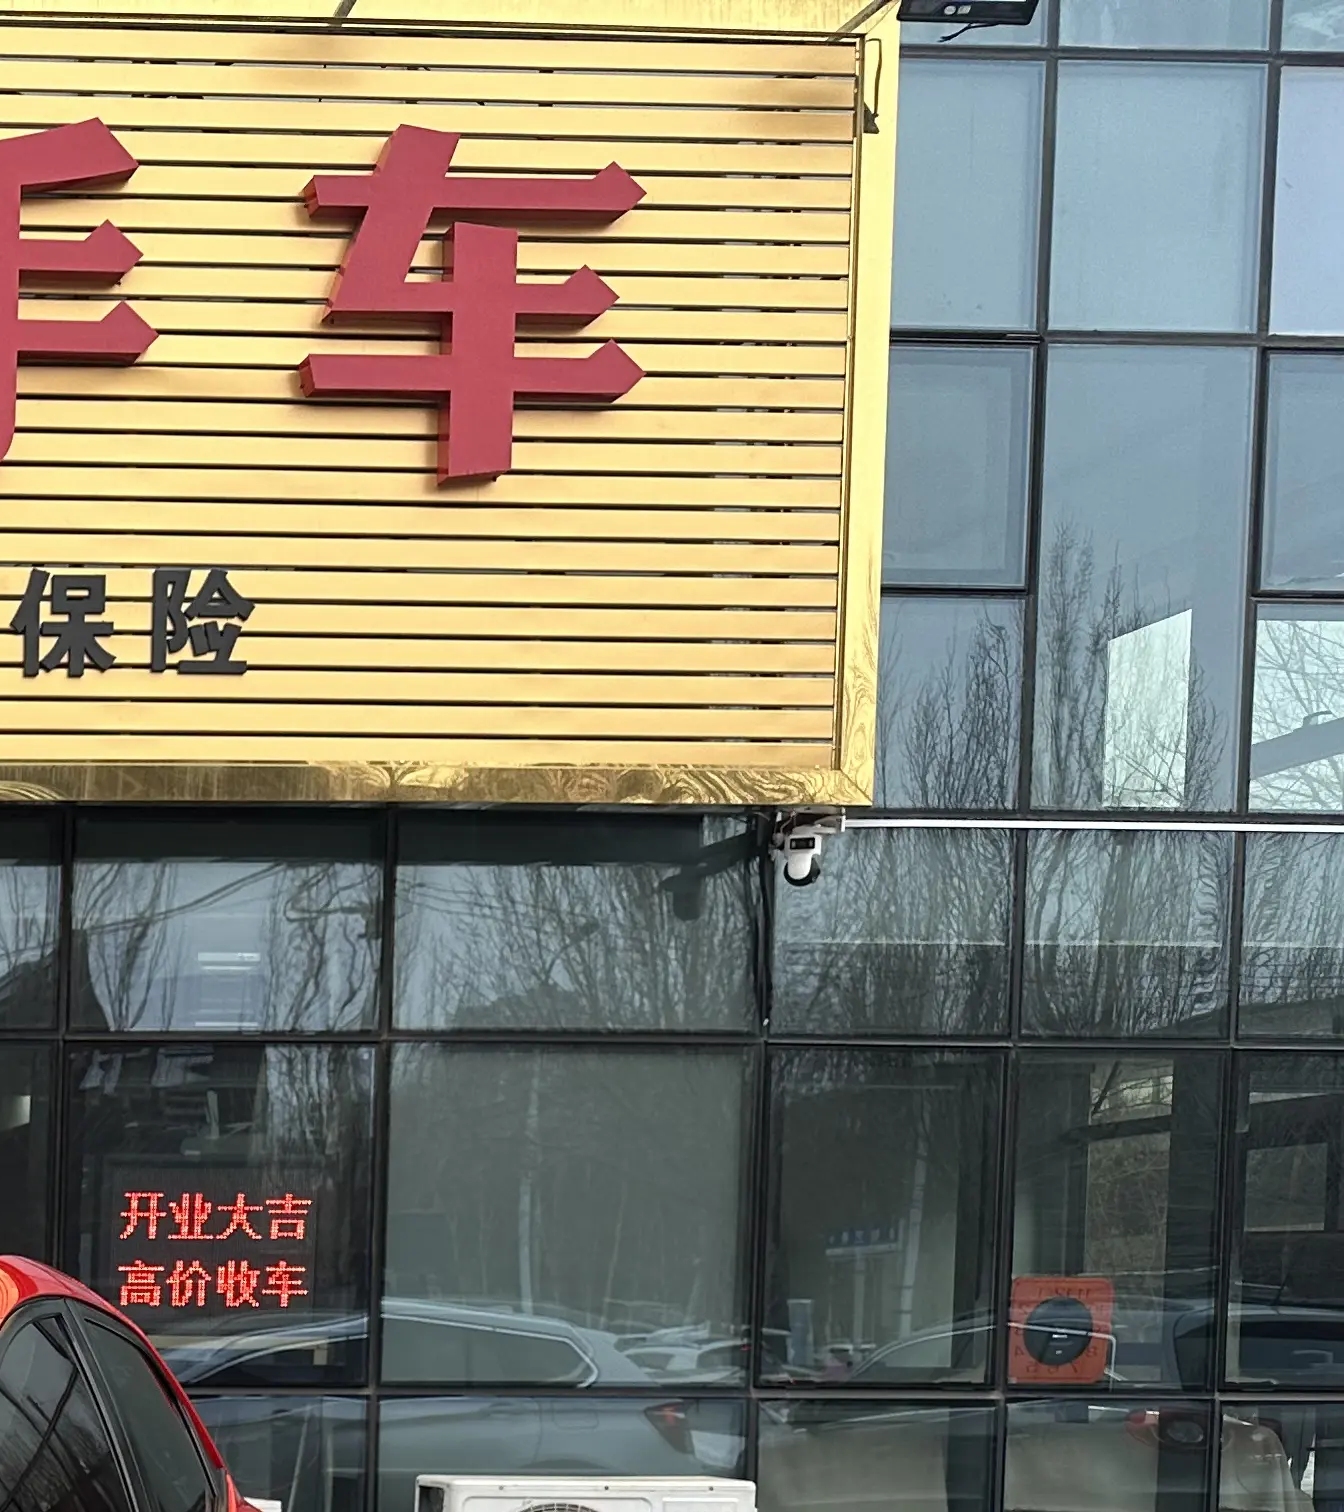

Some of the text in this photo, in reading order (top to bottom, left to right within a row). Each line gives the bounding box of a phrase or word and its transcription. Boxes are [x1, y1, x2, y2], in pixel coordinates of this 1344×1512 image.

[10, 568, 256, 678] 保险
[118, 1190, 314, 1240] 开业大吉
[117, 1259, 310, 1308] 高价收车
